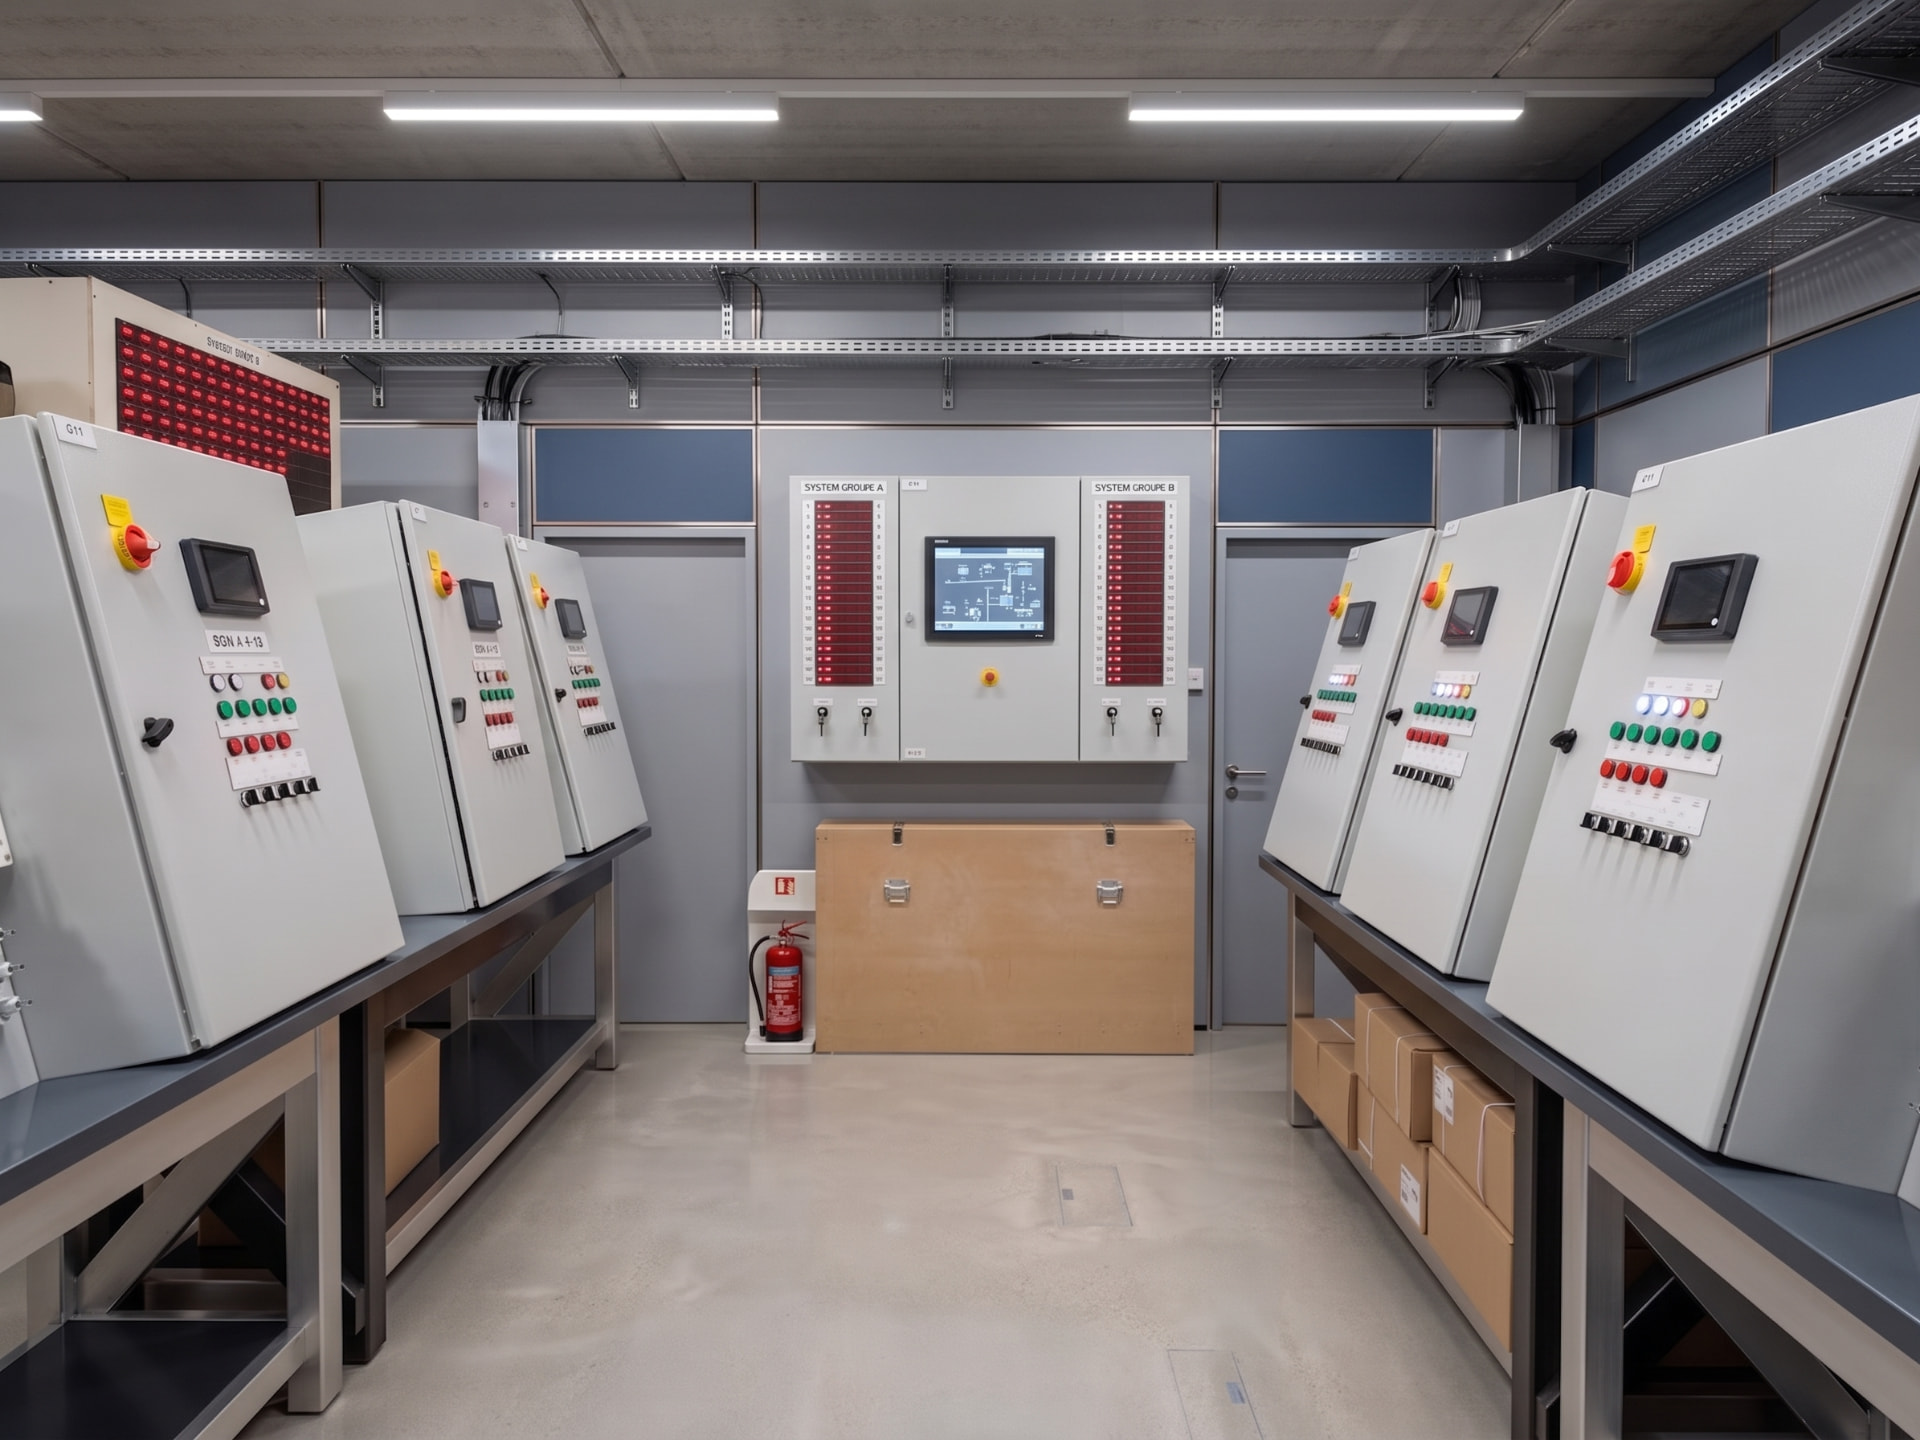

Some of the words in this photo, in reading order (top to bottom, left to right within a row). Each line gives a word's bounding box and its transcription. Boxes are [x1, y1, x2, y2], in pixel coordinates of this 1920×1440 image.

[66, 423, 84, 436] G11
[804, 483, 840, 492] SYSTEM
[841, 483, 875, 492] GROUPE
[876, 483, 884, 492] A
[1095, 483, 1131, 492] SYSTEM
[1132, 483, 1166, 492] GROUPE
[1168, 483, 1175, 492] B
[212, 634, 235, 647] SGN
[236, 635, 244, 647] A
